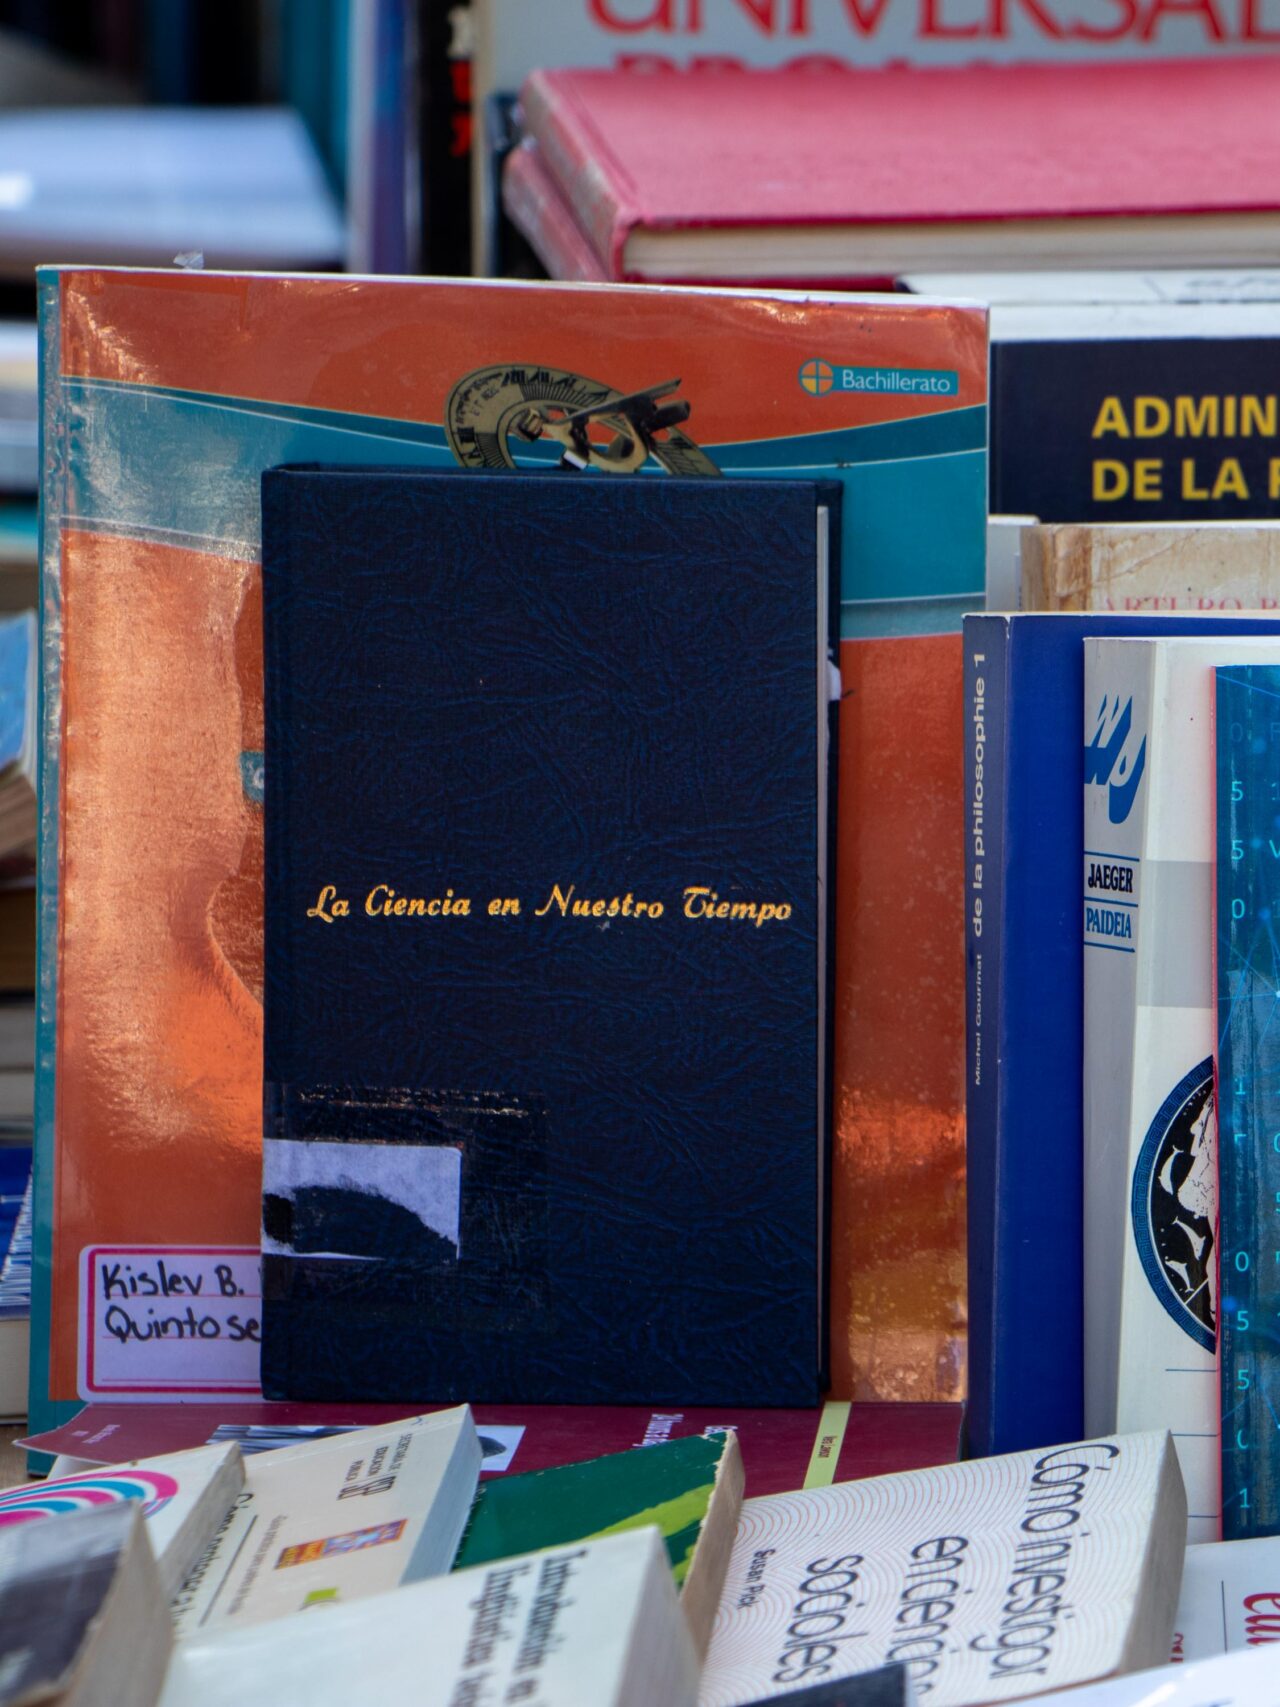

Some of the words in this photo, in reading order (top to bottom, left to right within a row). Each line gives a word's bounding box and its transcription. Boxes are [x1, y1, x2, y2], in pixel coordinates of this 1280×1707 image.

[842, 369, 951, 393] Bachillerato
[1092, 458, 1163, 502] DE
[1181, 458, 1249, 501] LA
[974, 653, 985, 668] 1
[973, 677, 985, 857] philosophie
[972, 863, 983, 889] la
[1088, 863, 1134, 893] JAEGER
[306, 884, 350, 923] La
[364, 883, 472, 918] Ciencia
[488, 895, 521, 916] en
[535, 883, 664, 918] Nuestro
[682, 885, 792, 928] Tiempo
[973, 898, 983, 938] de
[1086, 907, 1132, 939] PAIDEIA
[975, 954, 983, 1027] Gourinat
[974, 1032, 982, 1085] Michel
[102, 1260, 202, 1300] Kislev
[214, 1264, 244, 1296] B.
[105, 1305, 221, 1343] Quinto
[1020, 1443, 1120, 1533] Cómo
[905, 1535, 969, 1580] en
[772, 1555, 869, 1683] sociales
[969, 1531, 1091, 1680] investigar
